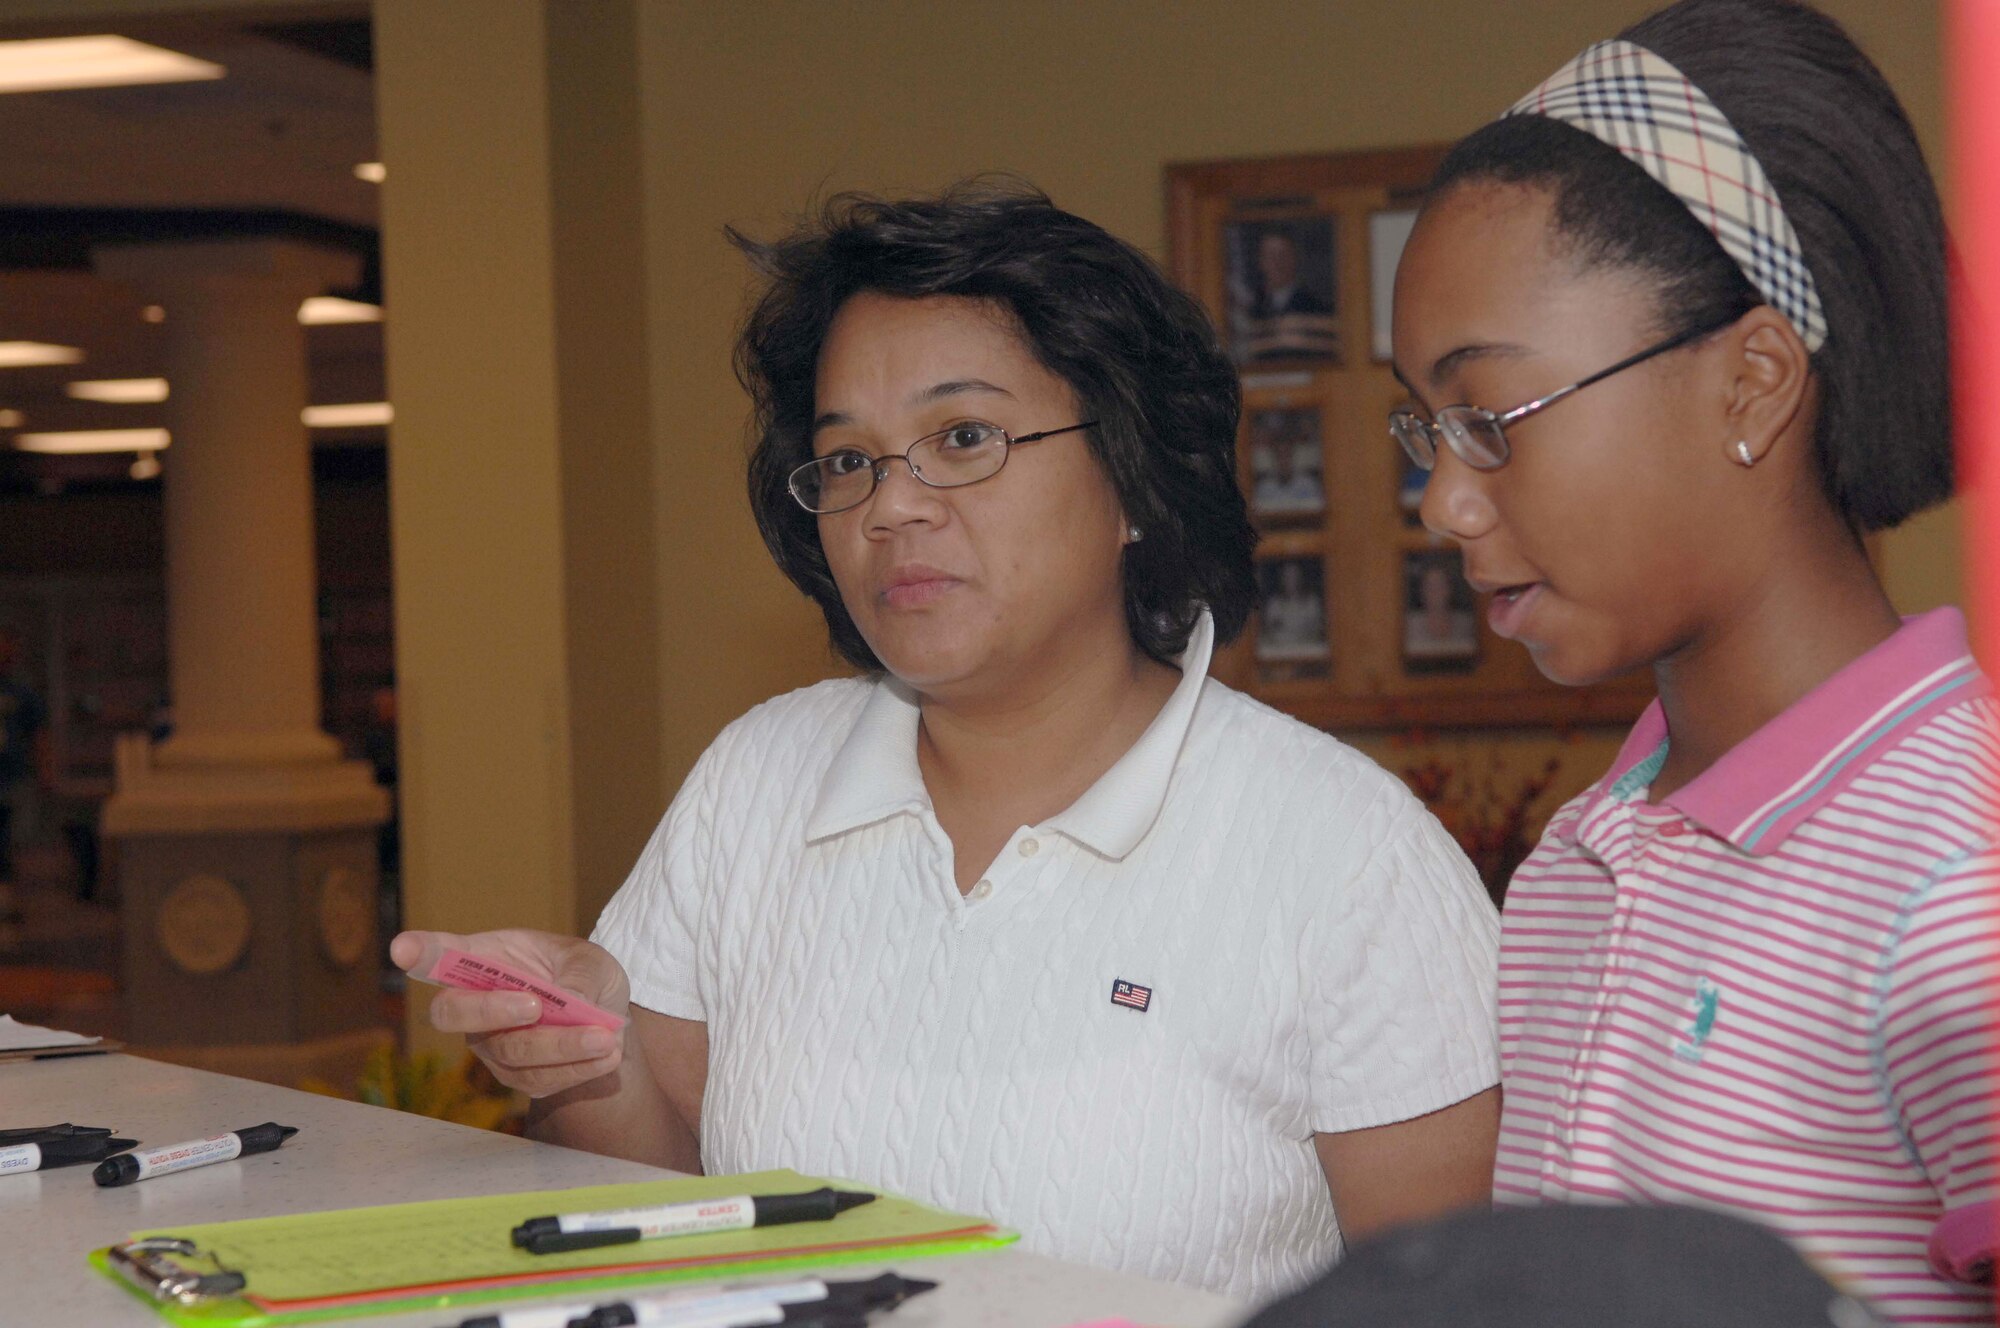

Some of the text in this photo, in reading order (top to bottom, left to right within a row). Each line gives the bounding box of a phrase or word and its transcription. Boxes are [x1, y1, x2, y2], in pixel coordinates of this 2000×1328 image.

[485, 967, 501, 976] AFB
[501, 973, 528, 988] YOUTH
[527, 985, 567, 1007] PROGRAMS
[1118, 983, 1130, 994] RL
[698, 1204, 740, 1216] CENTER
